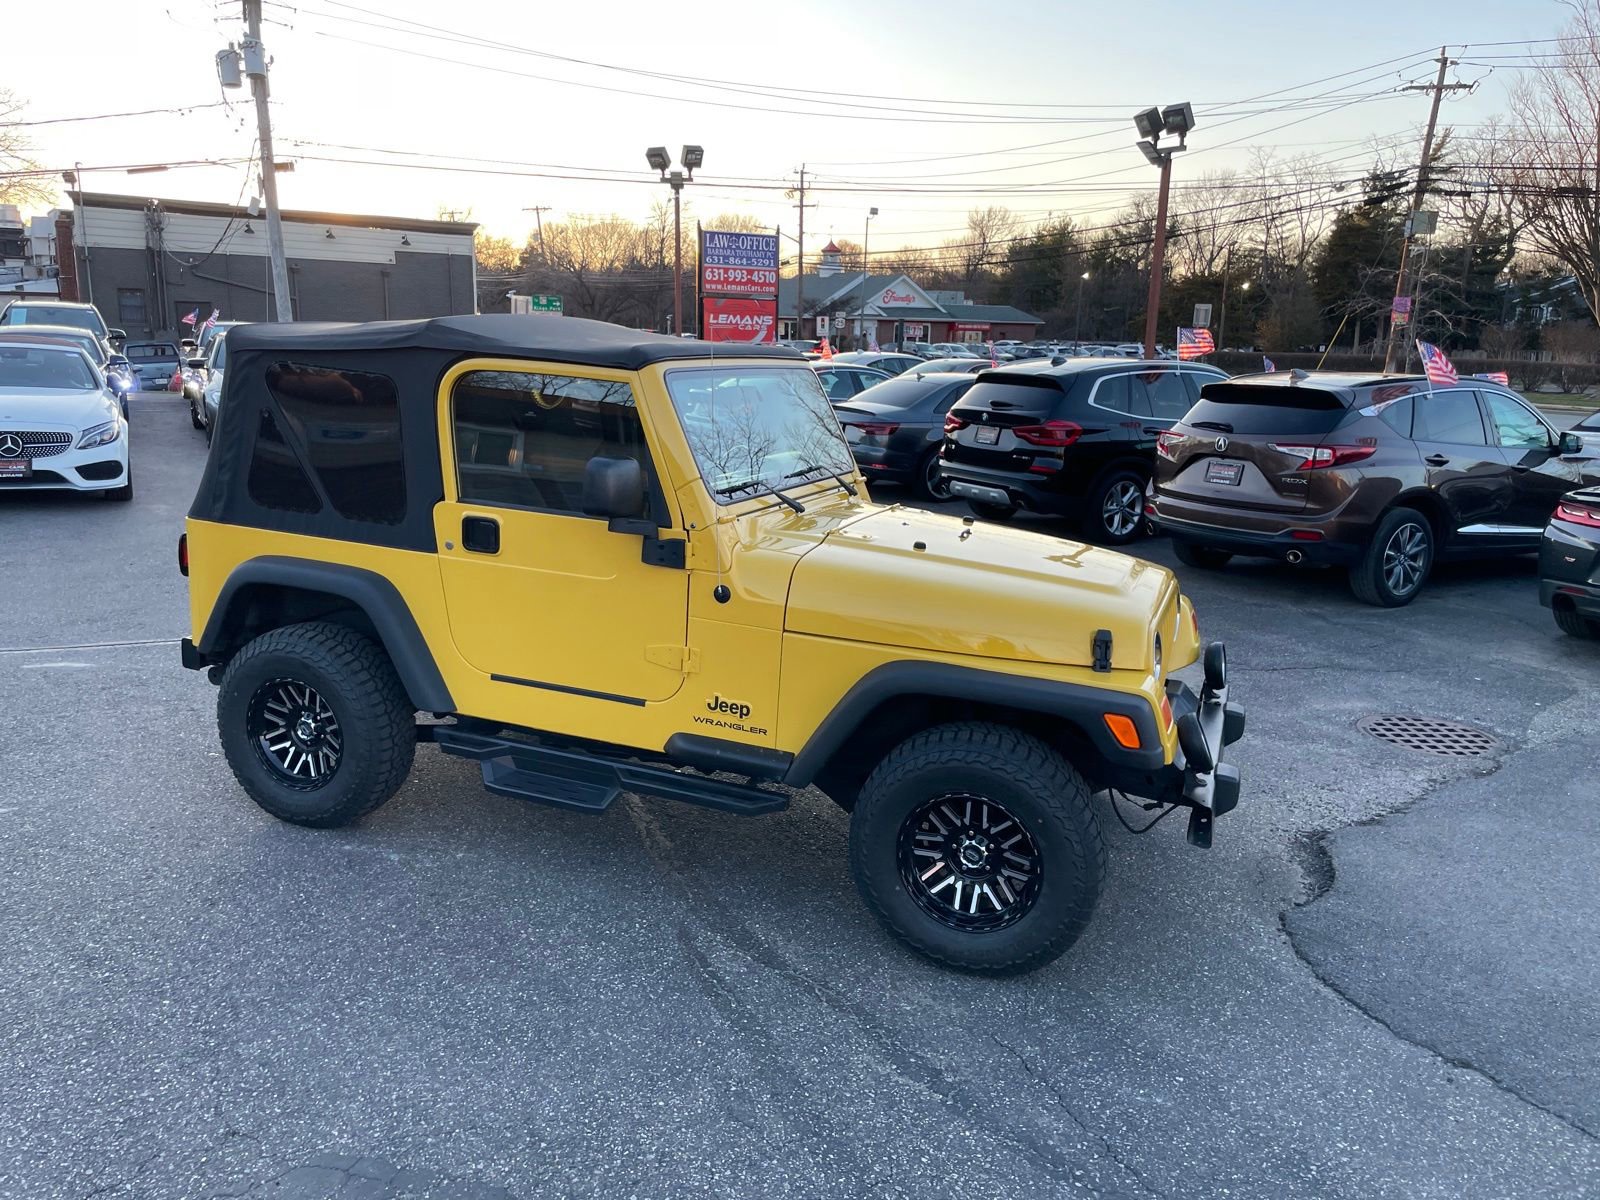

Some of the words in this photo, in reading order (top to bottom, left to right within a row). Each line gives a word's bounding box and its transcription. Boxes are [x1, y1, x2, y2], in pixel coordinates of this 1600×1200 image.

[706, 234, 730, 248] LAW
[739, 236, 776, 251] OFFICE
[707, 248, 735, 256] BARBARA
[766, 251, 774, 259] PC
[706, 256, 774, 267] 631-864-5291
[706, 269, 776, 283] 631-993-4510
[706, 283, 774, 292] www.LemansCars.com
[709, 314, 773, 325] LEMANS
[1281, 477, 1308, 485] RDX
[707, 695, 751, 719] Jeep
[693, 715, 768, 736] WRANGLER
